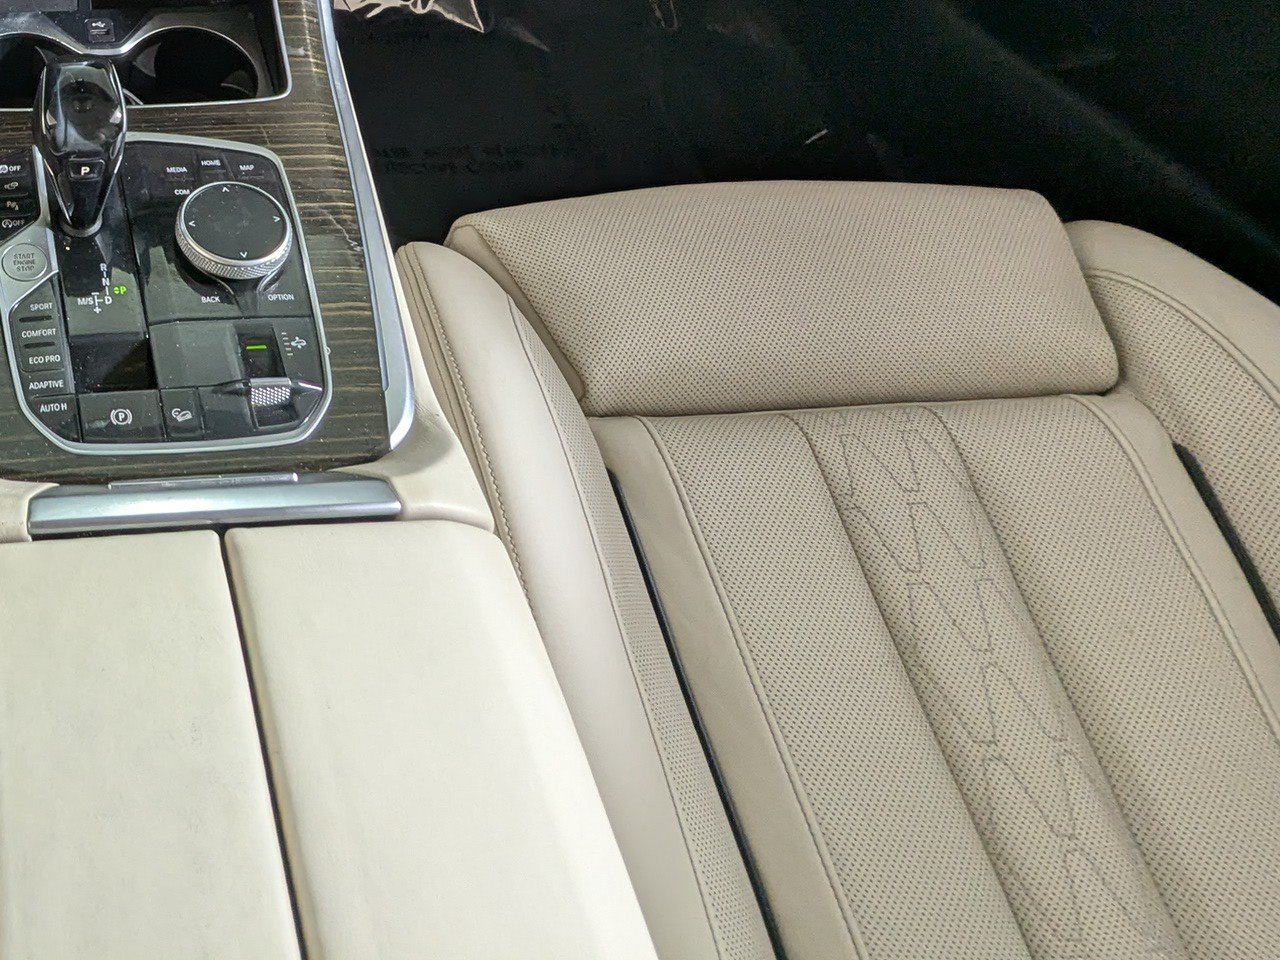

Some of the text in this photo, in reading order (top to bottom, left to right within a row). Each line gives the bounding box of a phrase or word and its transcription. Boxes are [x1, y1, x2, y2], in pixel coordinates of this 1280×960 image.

[81, 166, 90, 176] P
[100, 263, 108, 271] R
[102, 277, 110, 286] N
[77, 297, 94, 305] M/S
[267, 293, 295, 301] OPTION
[29, 302, 53, 312] SPORT
[21, 328, 57, 338] COMFORT
[28, 354, 61, 365] ECO PRO
[28, 379, 64, 390] ADAPTIVE
[40, 402, 68, 413] AUTO H
